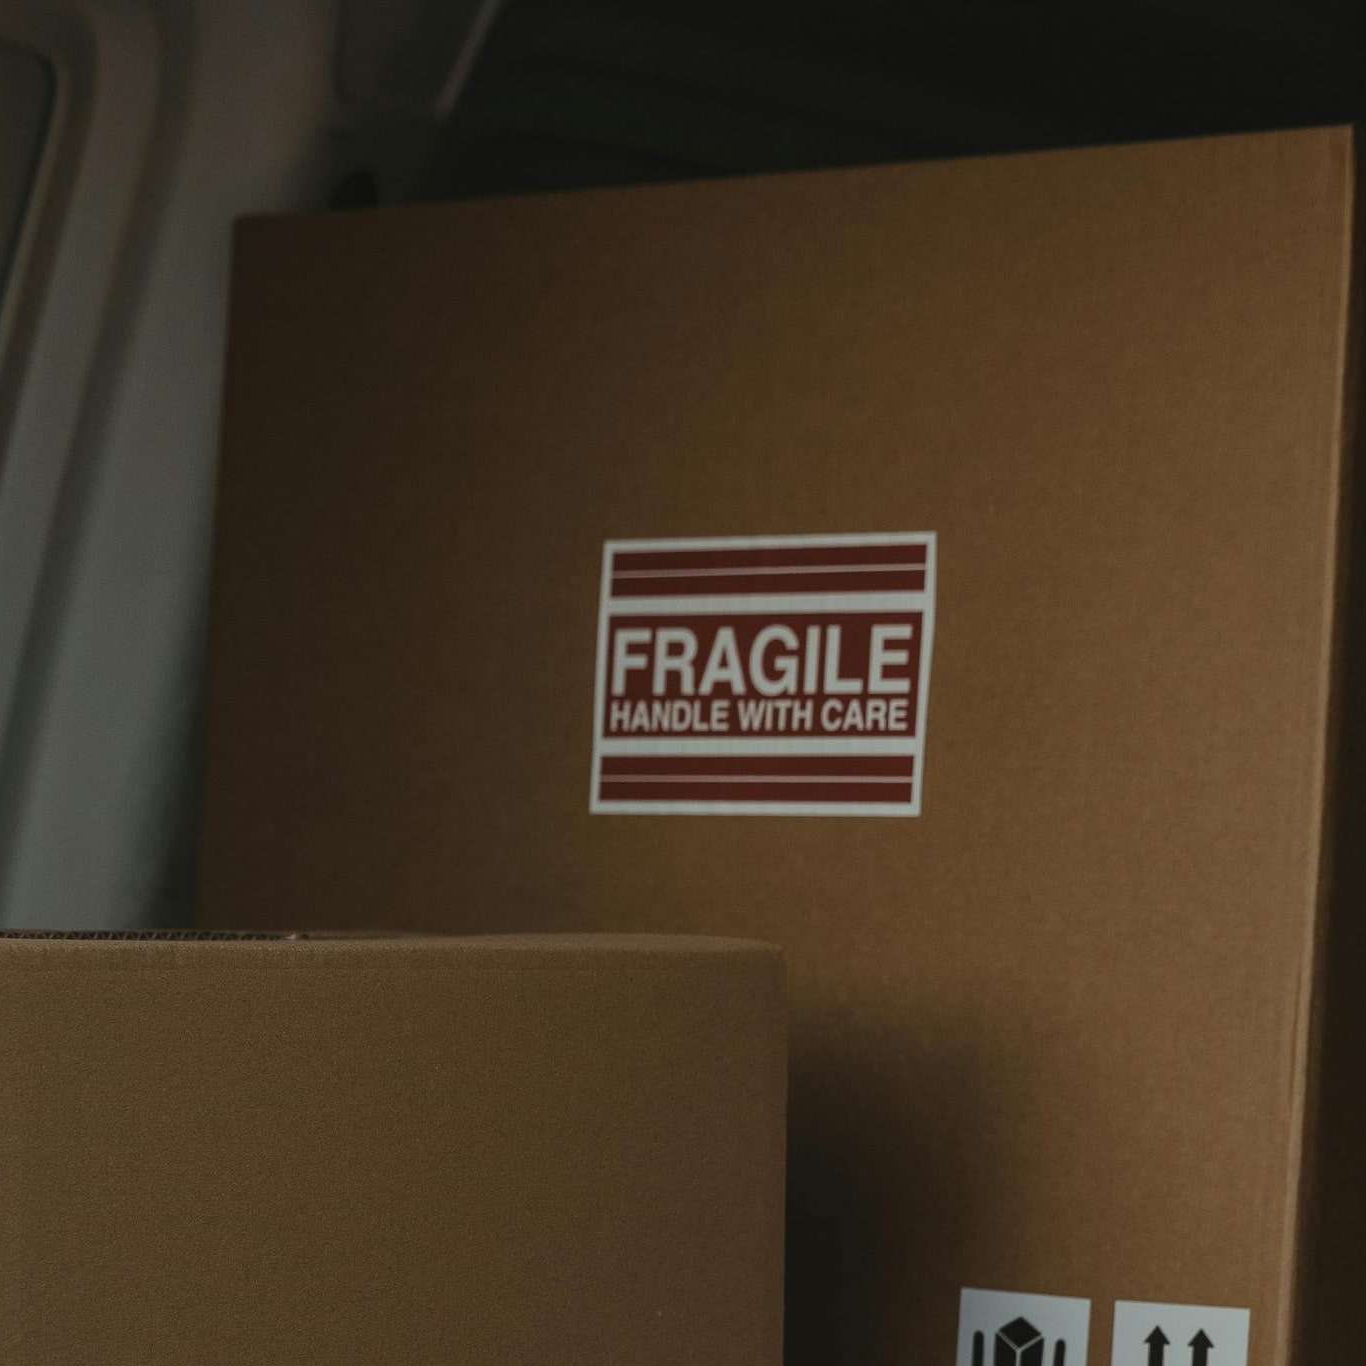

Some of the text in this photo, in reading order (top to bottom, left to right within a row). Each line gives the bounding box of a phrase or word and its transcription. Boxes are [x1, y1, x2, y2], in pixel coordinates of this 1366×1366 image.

[611, 624, 913, 697] FRAGILE
[610, 698, 908, 732] HANDLE WITH CARE
